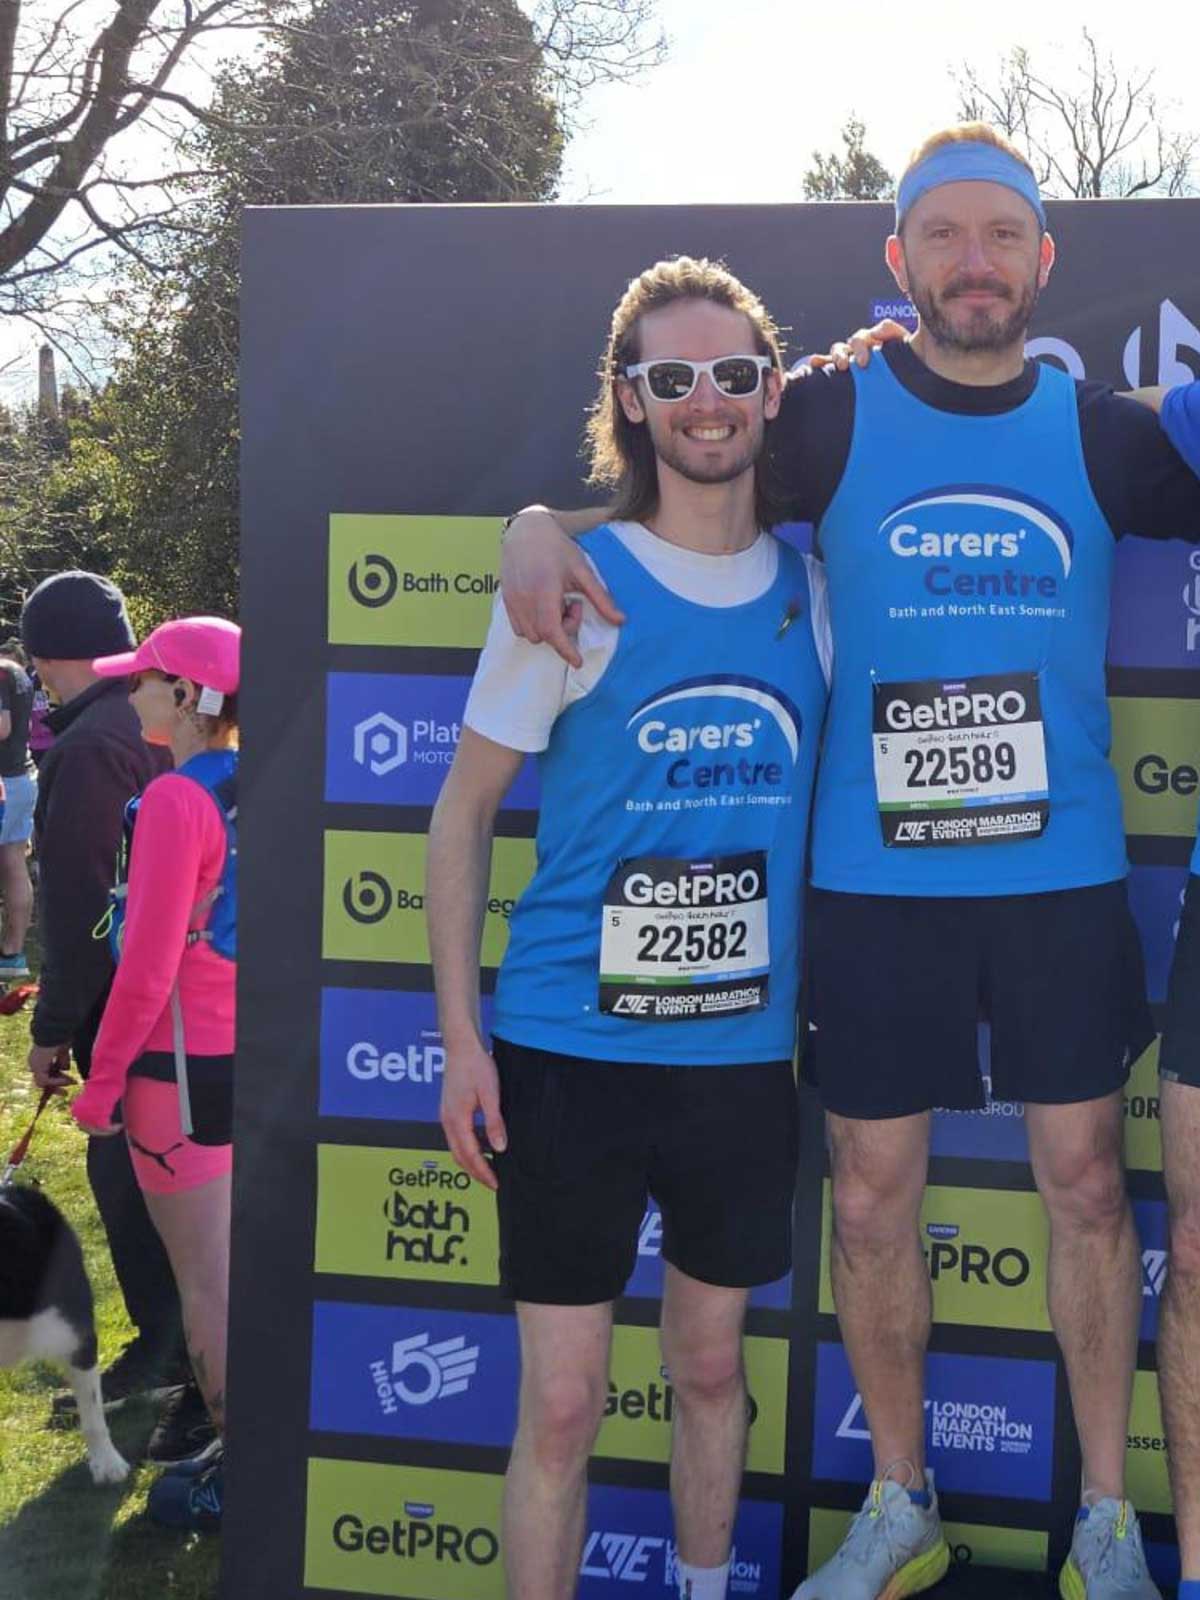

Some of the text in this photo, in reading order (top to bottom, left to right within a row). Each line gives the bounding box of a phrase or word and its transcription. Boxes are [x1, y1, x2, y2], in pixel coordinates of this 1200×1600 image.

[889, 524, 1026, 557] Carers'
[403, 573, 449, 593] Bath
[924, 565, 1057, 598] Centre
[921, 606, 944, 617] and
[948, 604, 986, 616] North
[990, 604, 1016, 615] East
[886, 690, 1026, 730] GetPRO
[413, 720, 460, 743] Plat
[638, 718, 762, 753] Carers'
[880, 743, 889, 755] 5
[667, 758, 783, 790] Centre
[904, 742, 1016, 788] 22589
[626, 799, 653, 812] Bath
[656, 799, 681, 811] and
[931, 818, 978, 831] LONDON
[979, 811, 1042, 827] MARATHON
[932, 828, 973, 840] EVENTS
[624, 869, 759, 905] GetPRO
[611, 916, 620, 927] 5
[637, 920, 747, 962] 22582
[655, 1004, 697, 1015] EVENTS
[656, 994, 704, 1008] LONDON
[705, 987, 761, 1002] MARATHON
[347, 1042, 446, 1083] GetP
[388, 1168, 471, 1190] GetPRO
[384, 1190, 470, 1233] bath
[925, 1243, 1030, 1287] PRO
[369, 1360, 398, 1414] HIGH
[931, 1401, 1007, 1421] LONDON
[931, 1416, 1033, 1440] MARATHON
[931, 1433, 996, 1451] EVENTS
[332, 1514, 500, 1566] GetPRO
